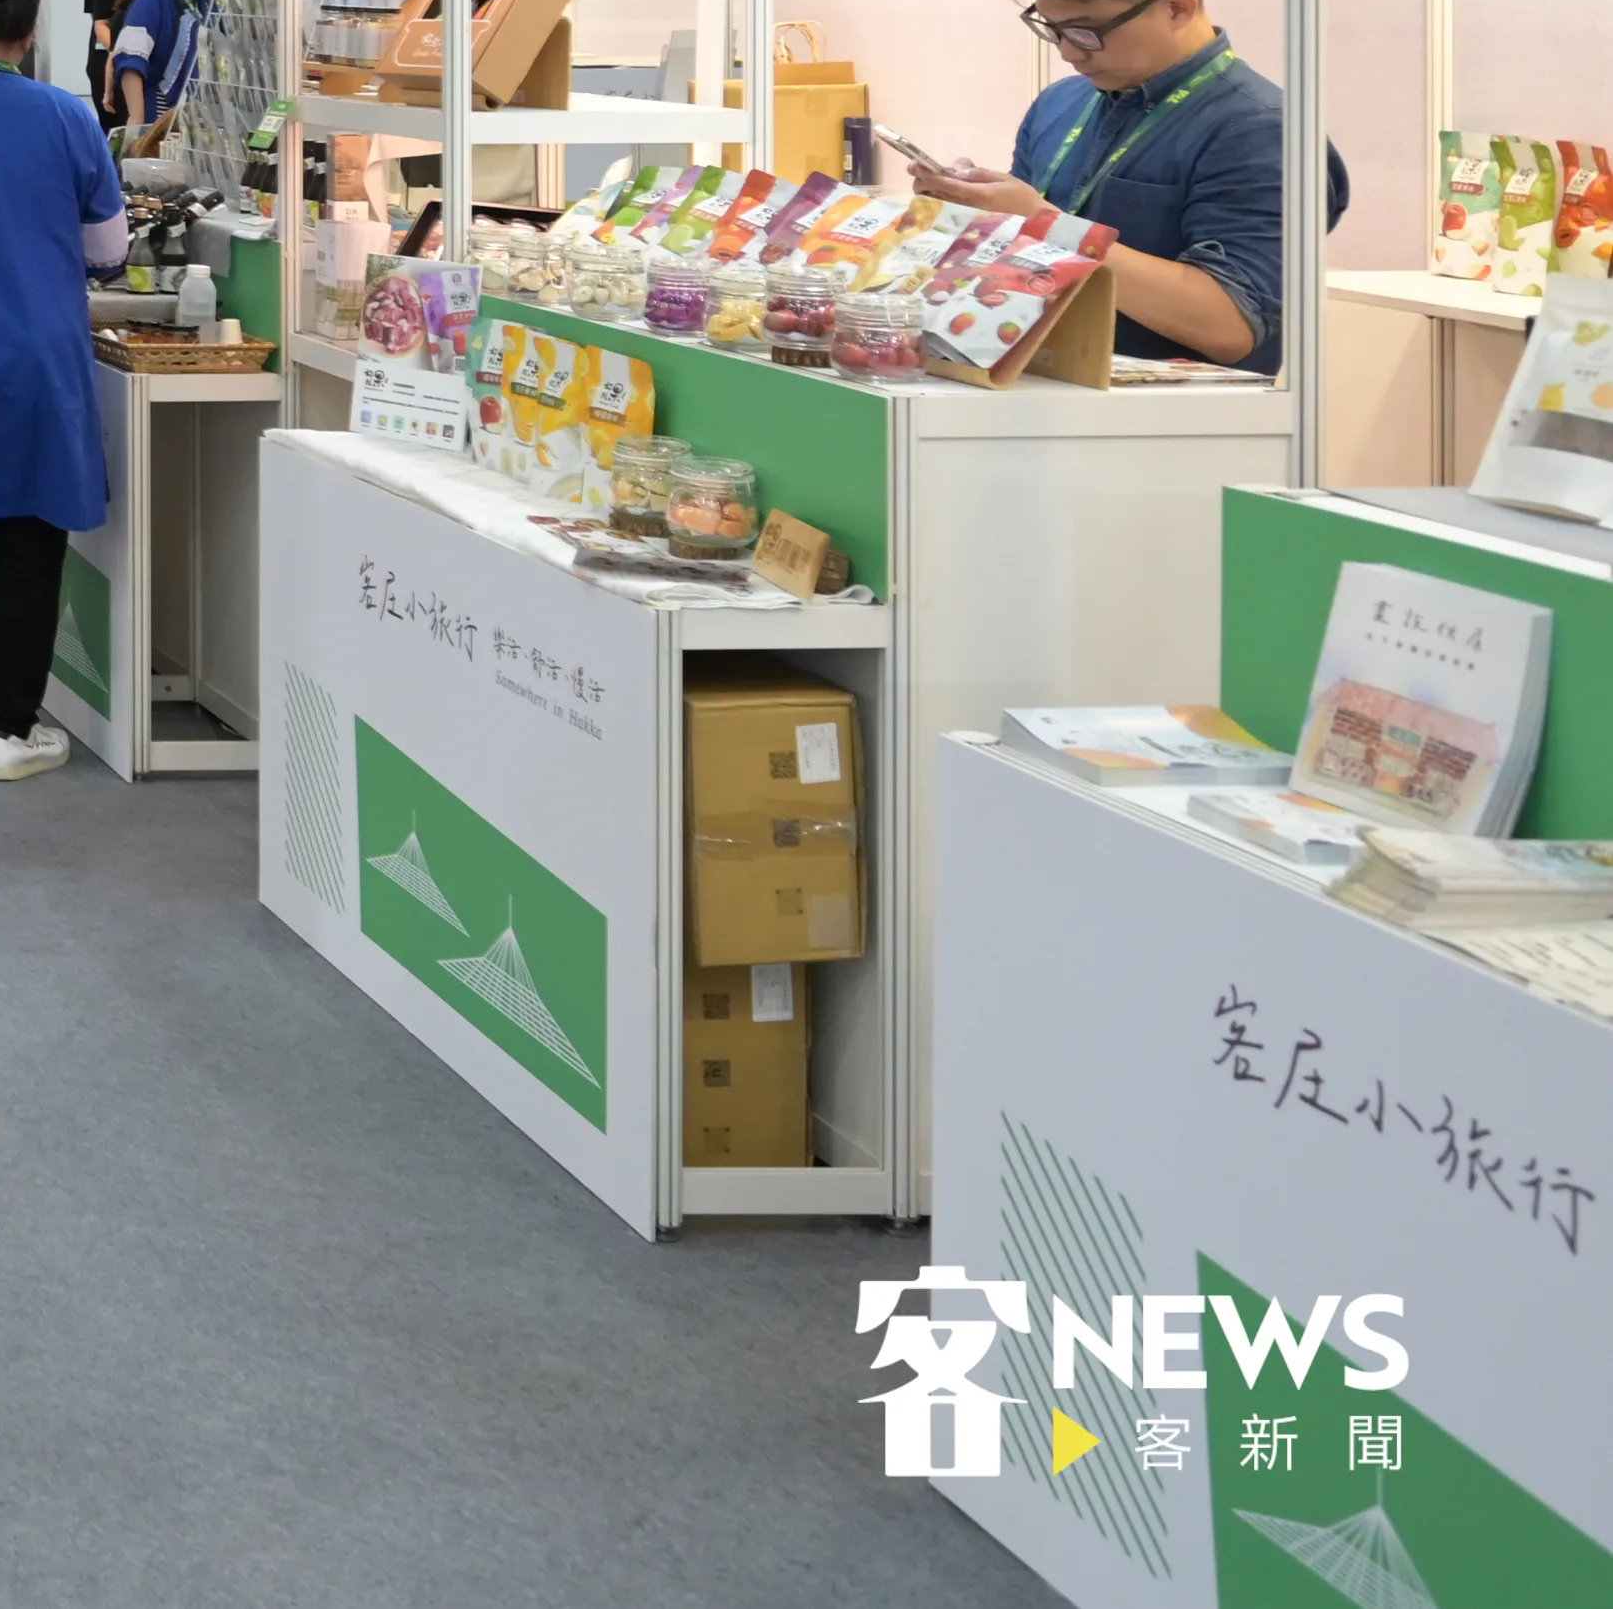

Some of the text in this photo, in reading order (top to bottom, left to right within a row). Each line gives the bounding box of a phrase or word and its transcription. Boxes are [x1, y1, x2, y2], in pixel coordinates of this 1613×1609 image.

[495, 670, 603, 741] Somewhere in Hakka
